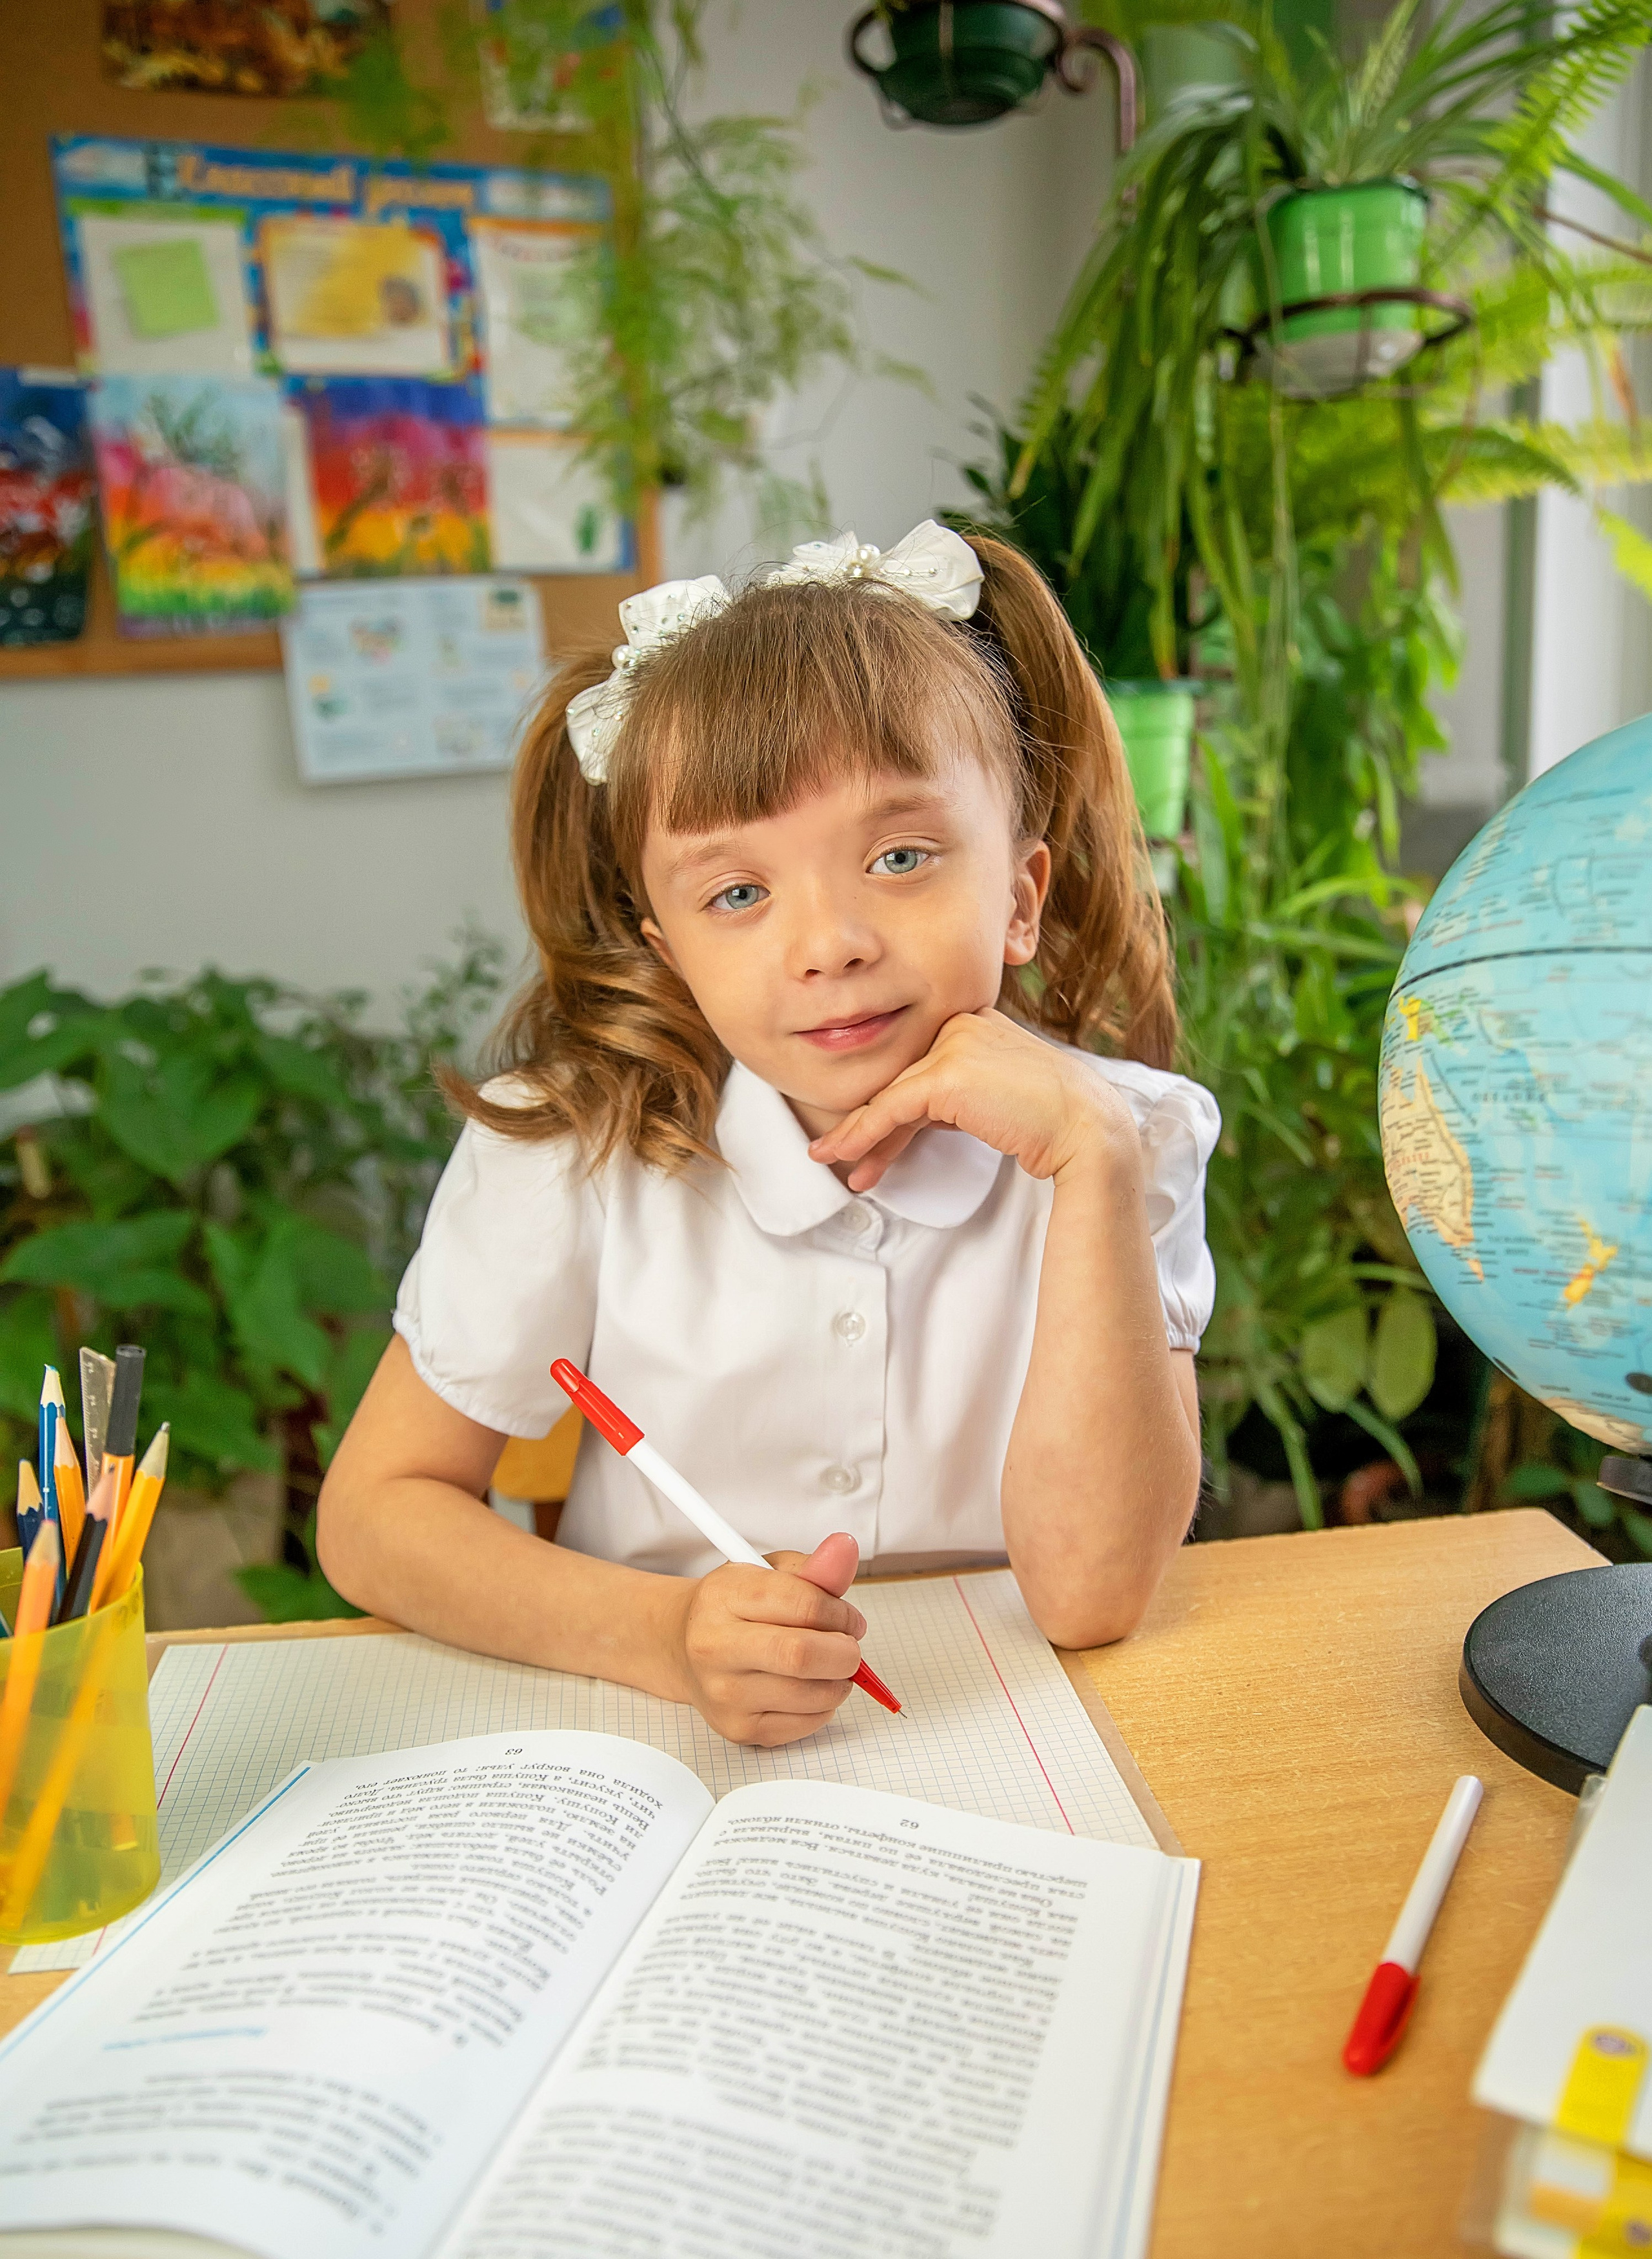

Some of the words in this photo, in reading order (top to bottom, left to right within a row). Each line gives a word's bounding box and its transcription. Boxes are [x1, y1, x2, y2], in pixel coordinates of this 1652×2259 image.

[521, 1763, 570, 1772] вокруг
[579, 1769, 605, 1780] она
[383, 1771, 447, 1785] понюхает
[492, 1772, 549, 1782] Копуша
[388, 1778, 448, 1791] труслива.
[406, 1787, 445, 1796] вдруг
[447, 1782, 512, 1791] страшно:
[569, 1777, 623, 1799] укусит,
[344, 1788, 384, 1800] Долго
[418, 1792, 480, 1803] подошла
[486, 1792, 545, 1802] Копуша
[518, 1783, 608, 1805] незнакомая,
[612, 1779, 663, 1810] ходила
[328, 1800, 413, 1818] недоверчиво.
[335, 1797, 379, 1808] выско-
[479, 1802, 556, 1814] положили
[629, 1798, 655, 1820] чит,
[428, 1811, 460, 1819] раза
[469, 1812, 528, 1820] первого
[554, 1798, 620, 1826] Копушу.
[612, 1803, 649, 1832] Вещь
[317, 1812, 383, 1827] пригласи-
[347, 1816, 418, 1831] поставили
[539, 1818, 572, 1832] Для
[563, 1810, 615, 1836] землю,
[727, 1816, 782, 1825] яблоко,
[785, 1818, 840, 1830] отняли
[900, 1820, 919, 1830] 62
[307, 1827, 340, 1839] улей
[353, 1825, 408, 1839] решили
[481, 1822, 535, 1832] вышло
[625, 1824, 644, 1839] ли
[733, 1827, 810, 1836] вырывала
[505, 1834, 547, 1848] улей,
[541, 1831, 560, 1840] не
[620, 1835, 636, 1850] на
[714, 1837, 787, 1846] медвежья
[820, 1832, 872, 1849] пятам,
[844, 1826, 916, 1849] конфеты,
[584, 1831, 630, 1862] учить.
[791, 1840, 819, 1851] Вся
[879, 1847, 898, 1856] по
[504, 1847, 544, 1863] была
[567, 1838, 621, 1871] съёмки
[825, 1845, 900, 1867] деваться.
[905, 1853, 922, 1862] её
[919, 1845, 1012, 1872] прилипшие
[552, 1847, 615, 1883] открыть
[902, 1863, 940, 1878] куда
[745, 1869, 771, 1877] что
[929, 1859, 1040, 1891] преследовала
[1015, 1870, 1087, 1888] шерстью
[571, 1869, 607, 1896] Роль
[943, 1874, 995, 1893] знала,
[998, 1889, 1018, 1898] не
[1048, 1888, 1085, 1899] стая
[1021, 1894, 1053, 1908] Она
